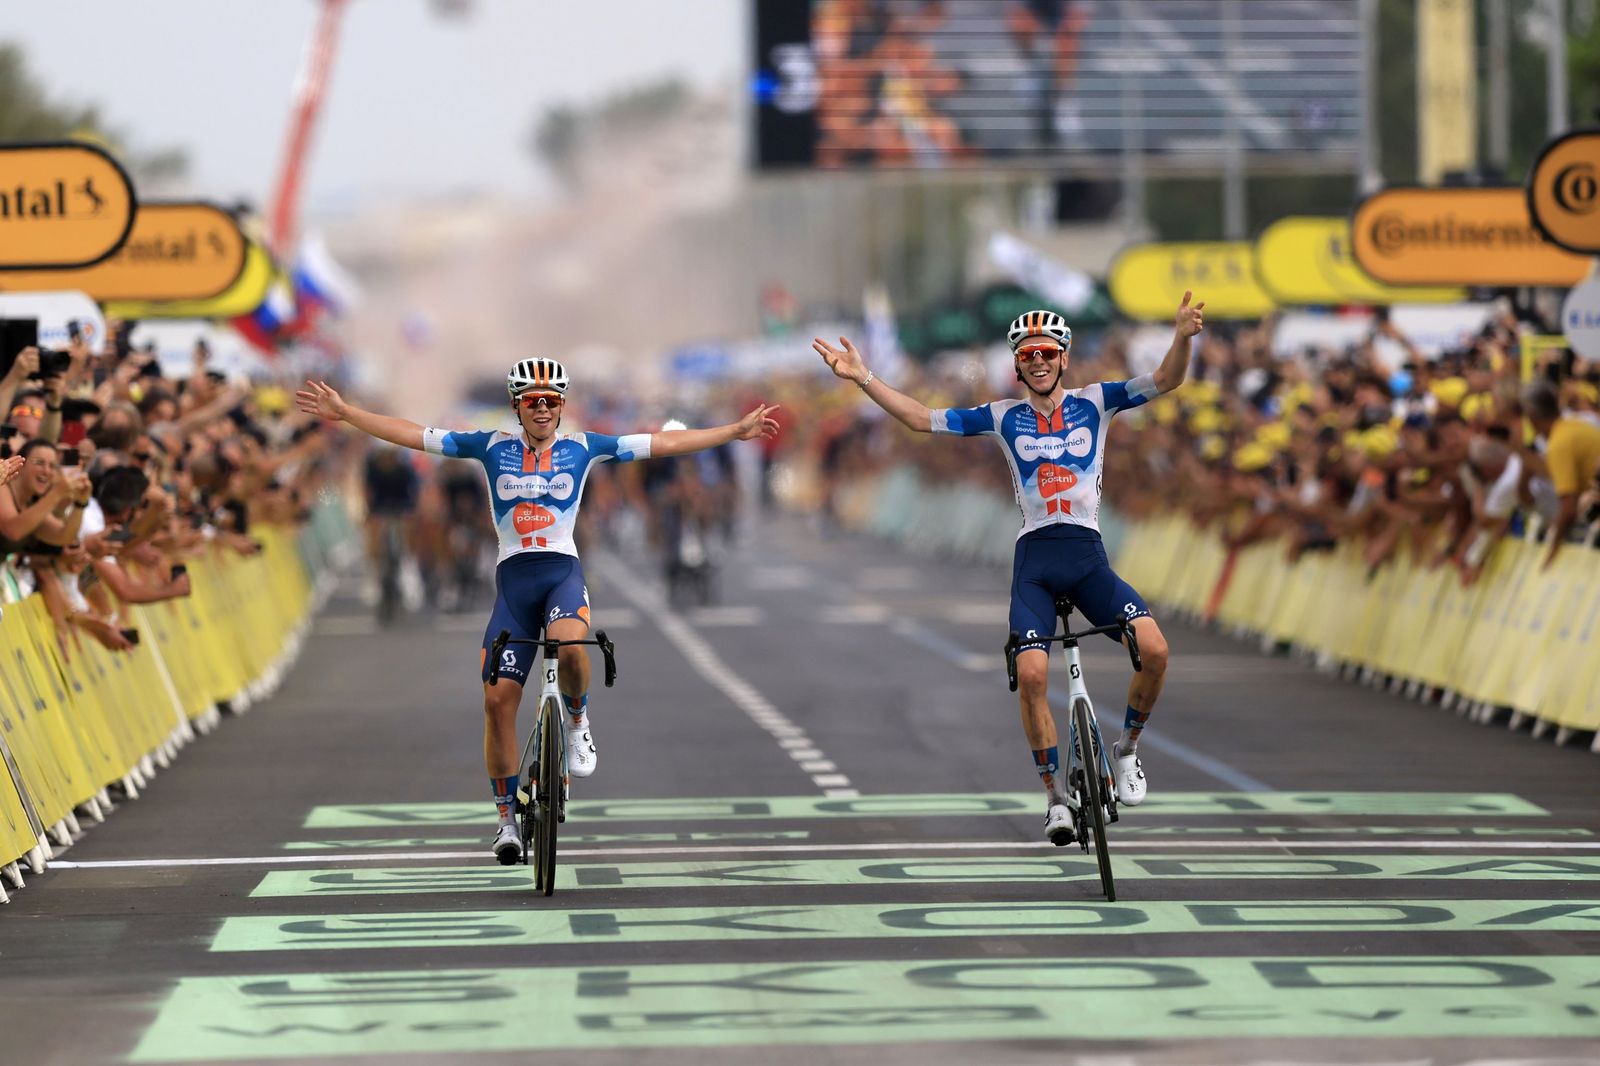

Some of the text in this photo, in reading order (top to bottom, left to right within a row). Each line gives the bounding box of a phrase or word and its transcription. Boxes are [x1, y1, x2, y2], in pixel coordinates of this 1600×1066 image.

[1041, 474, 1073, 488] postnl
[516, 514, 551, 525] postnl
[238, 961, 1600, 1008] SKOD
